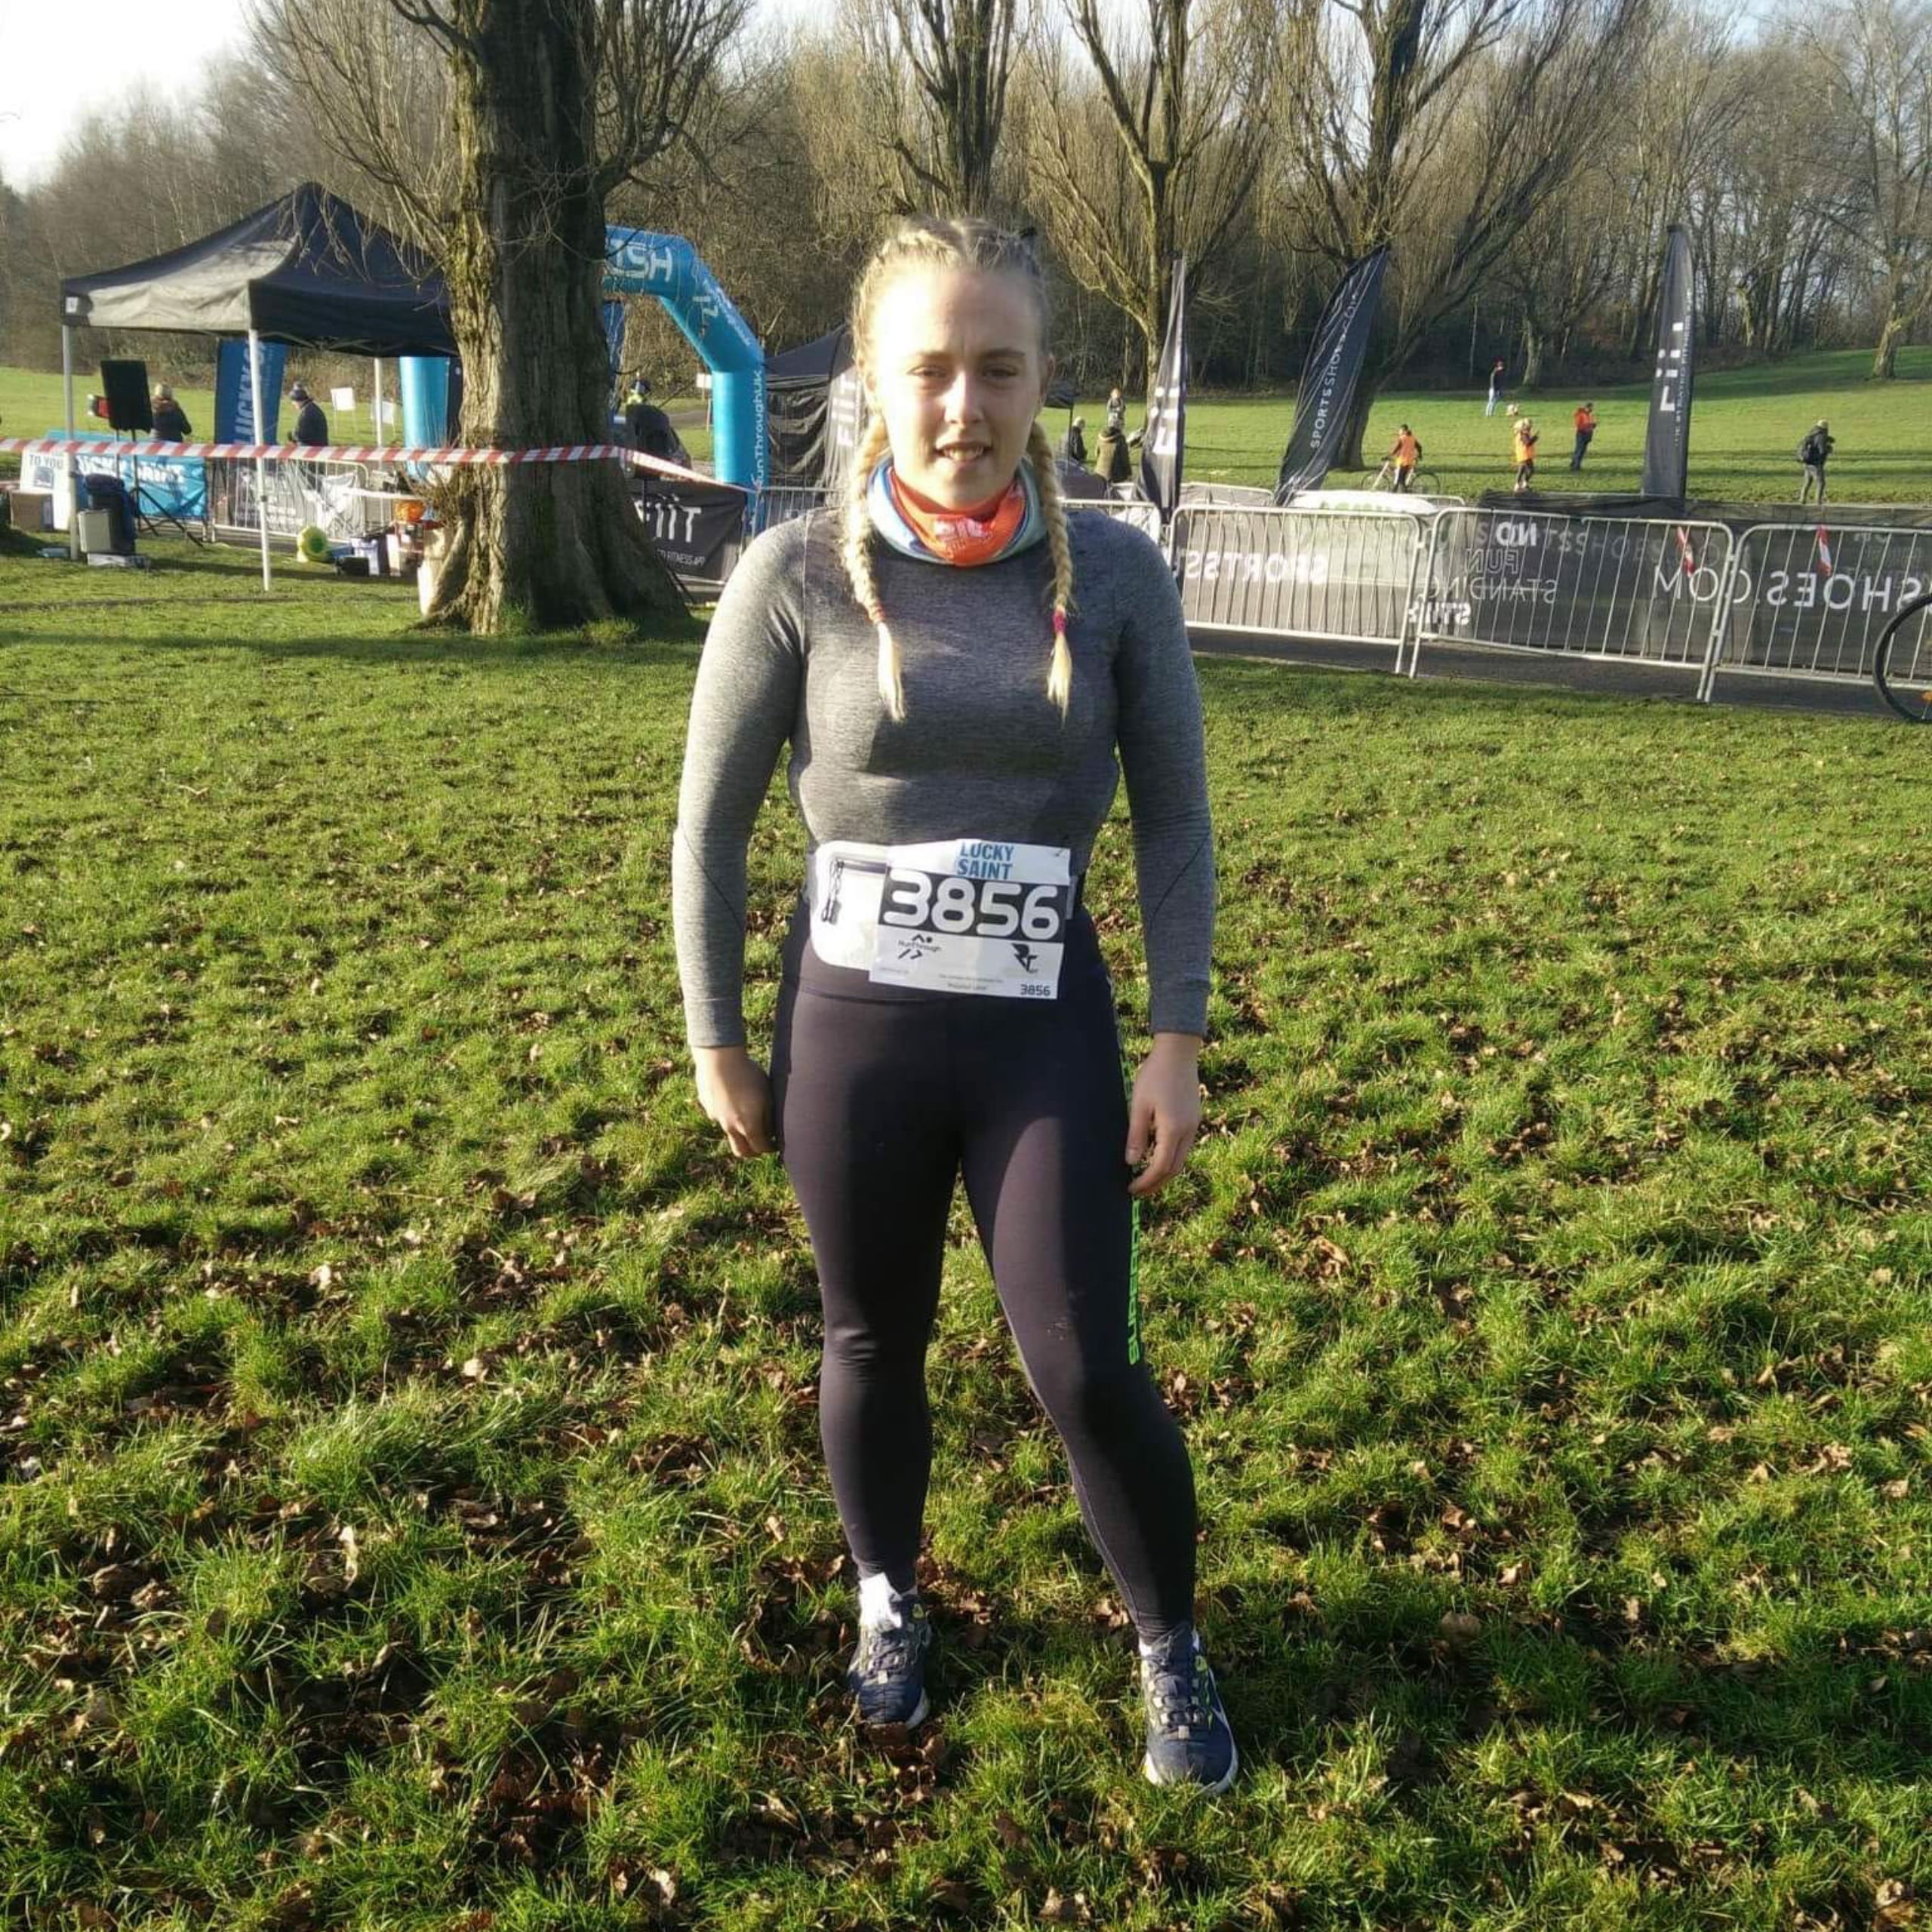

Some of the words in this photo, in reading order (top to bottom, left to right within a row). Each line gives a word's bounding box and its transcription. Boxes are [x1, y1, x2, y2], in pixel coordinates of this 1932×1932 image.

[959, 841, 1015, 863] LUCKY
[957, 859, 1014, 880] SAINT
[883, 868, 1060, 941] 3856
[1020, 983, 1051, 996] 3856
[1128, 1199, 1140, 1365] SUPERDR
